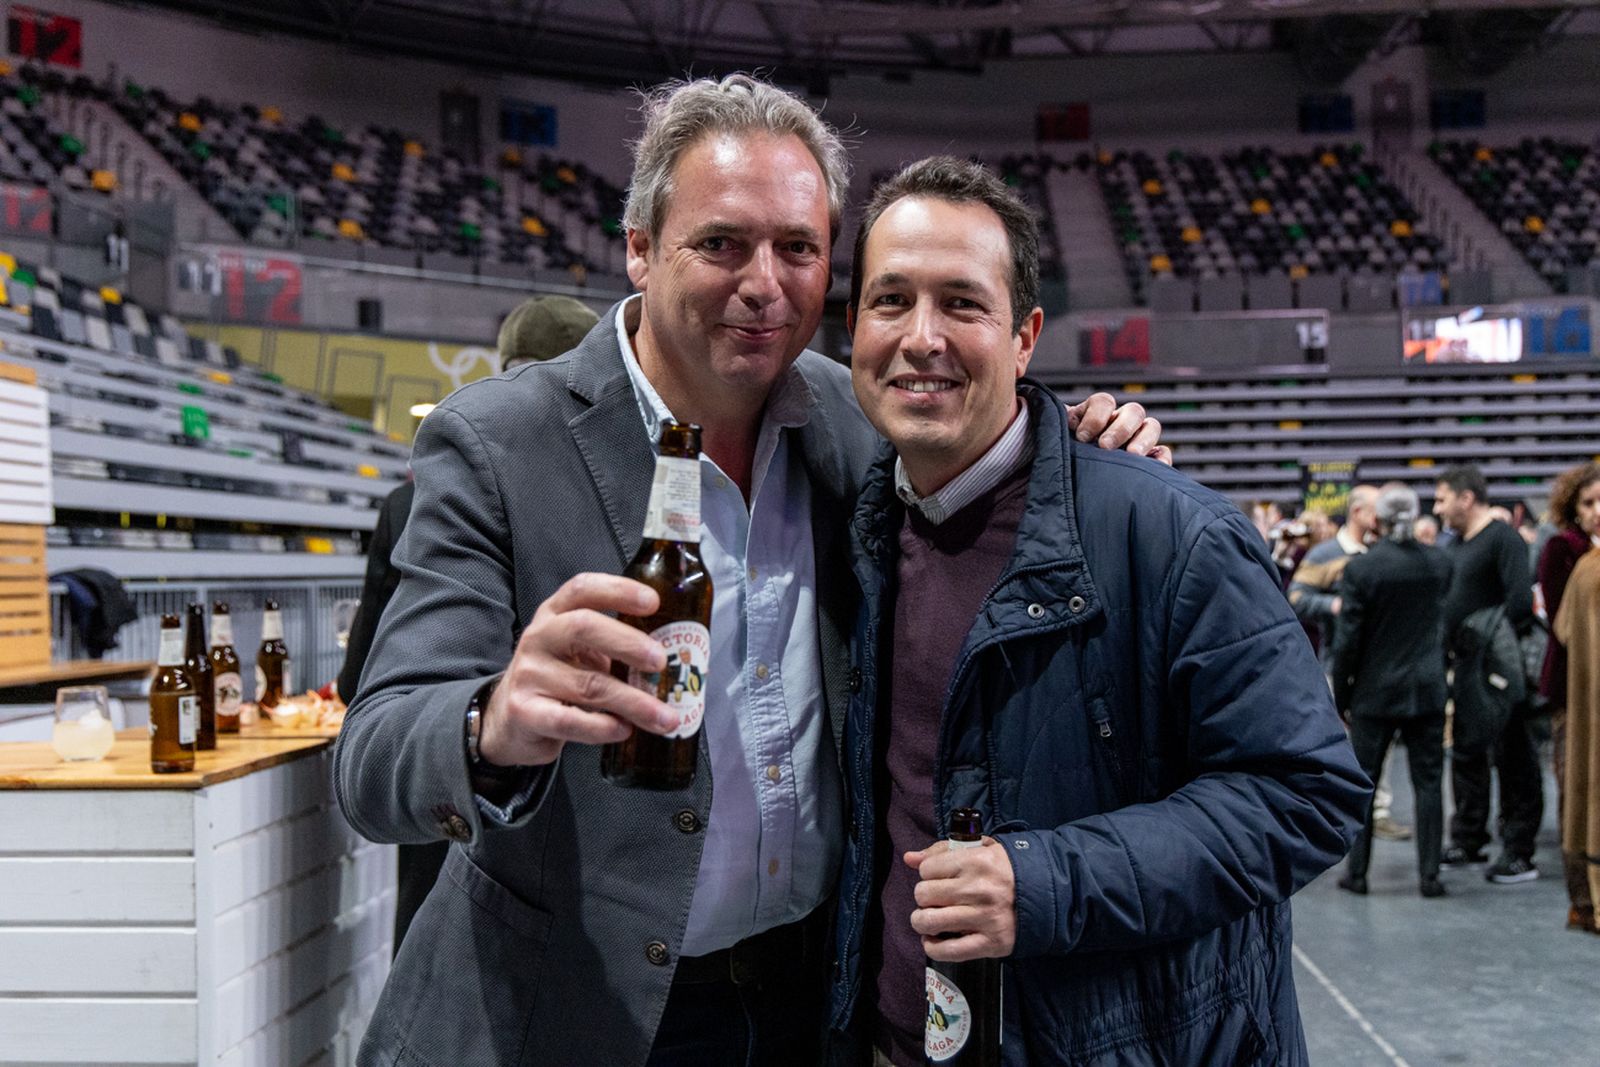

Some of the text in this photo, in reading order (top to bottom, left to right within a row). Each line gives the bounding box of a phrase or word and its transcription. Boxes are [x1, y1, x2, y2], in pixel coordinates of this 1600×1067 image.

[12, 6, 81, 67] 12
[187, 260, 222, 296] 11
[220, 254, 303, 325] 12
[1081, 317, 1150, 366] 14
[1296, 322, 1327, 348] 15
[1524, 306, 1590, 354] 16
[661, 633, 708, 659] CTORIA
[927, 1036, 954, 1051] LAGA
